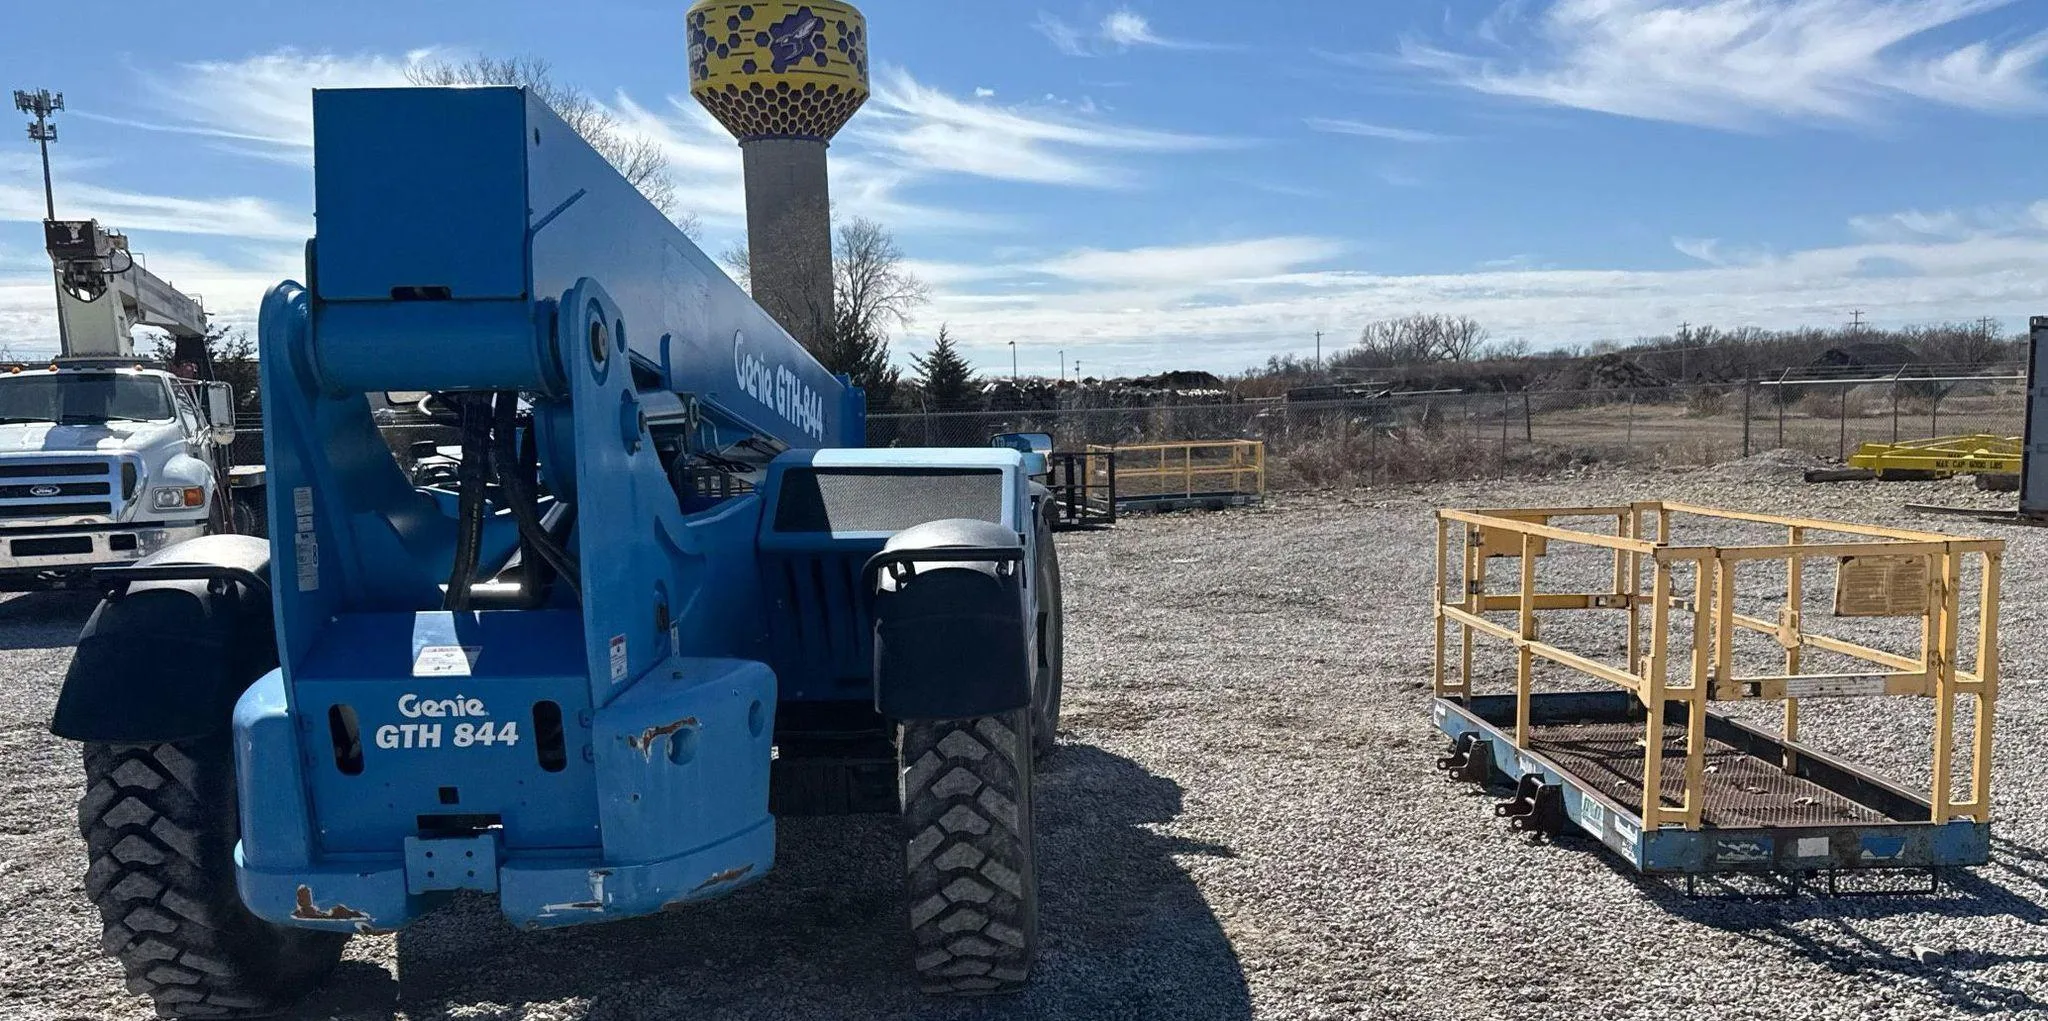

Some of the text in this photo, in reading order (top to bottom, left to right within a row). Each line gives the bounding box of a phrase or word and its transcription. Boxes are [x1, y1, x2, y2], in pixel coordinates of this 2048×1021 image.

[734, 329, 823, 443] Genie GTH-844
[398, 693, 488, 717] Genie
[376, 721, 519, 749] GTH 844
